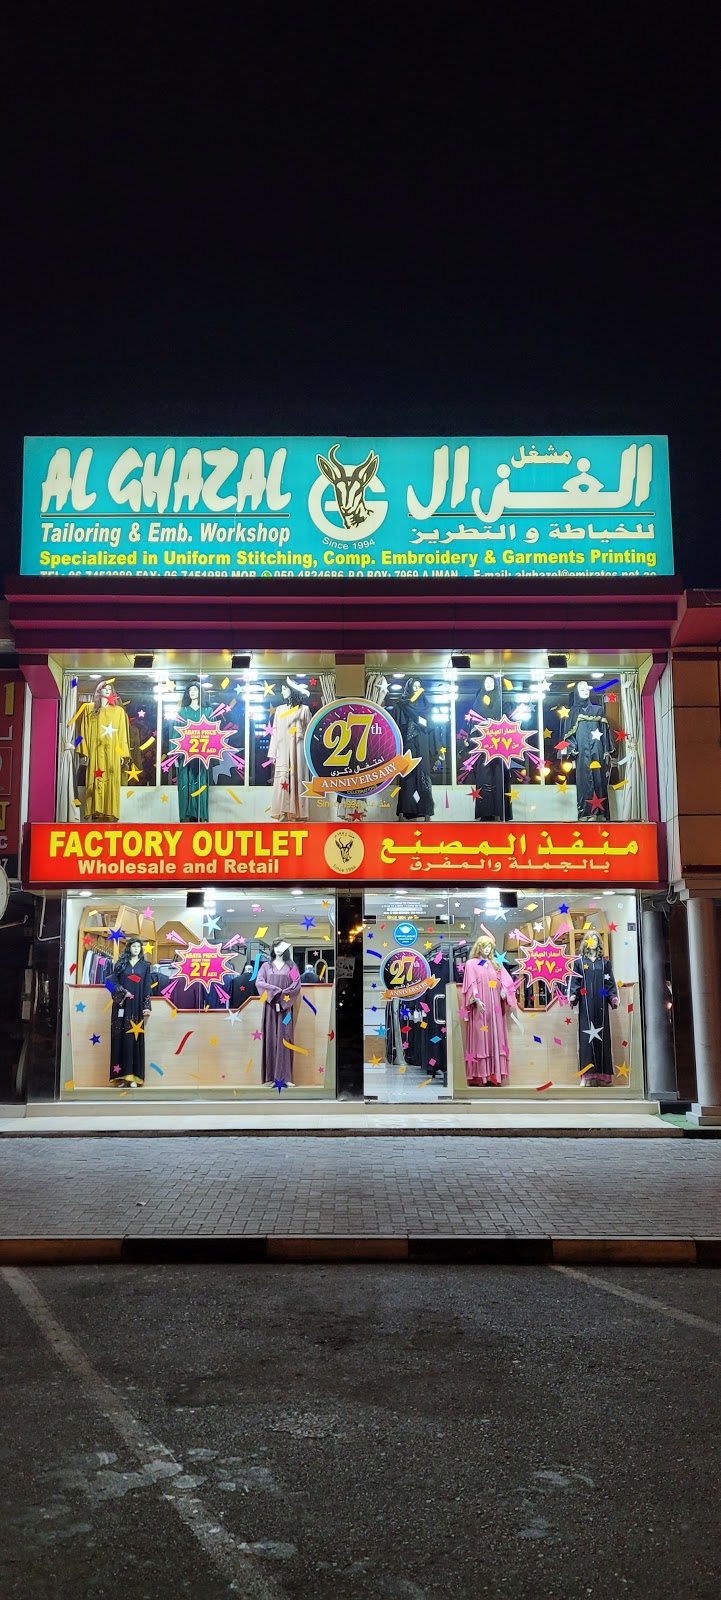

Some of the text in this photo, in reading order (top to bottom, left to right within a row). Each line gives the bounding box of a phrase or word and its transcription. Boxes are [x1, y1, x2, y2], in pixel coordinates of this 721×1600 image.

[510, 444, 573, 469] مشغل
[41, 447, 291, 513] AL GHAZAL
[407, 444, 653, 523] الغزال
[41, 522, 291, 547] Tailoring & Emb. Workshop
[322, 536, 376, 550] Since 1994
[408, 523, 655, 544] للخياطة و التطريز
[40, 549, 657, 568] Specialized in Uniform Stitching, Comp. Embroidery & Garments Printing
[188, 738, 210, 752] 27
[491, 737, 512, 750] ٢٧
[321, 761, 398, 788] ANNIVERSARY
[49, 830, 309, 858] FACTORY OUTLET
[380, 829, 639, 864] منفذ المصنع
[78, 859, 279, 875] Wholesale and Retail
[409, 856, 611, 873] بالجملة والمفرق
[190, 962, 210, 976] 27
[535, 960, 556, 974] ٢٧
[390, 982, 428, 996] ANNIVERSARY
